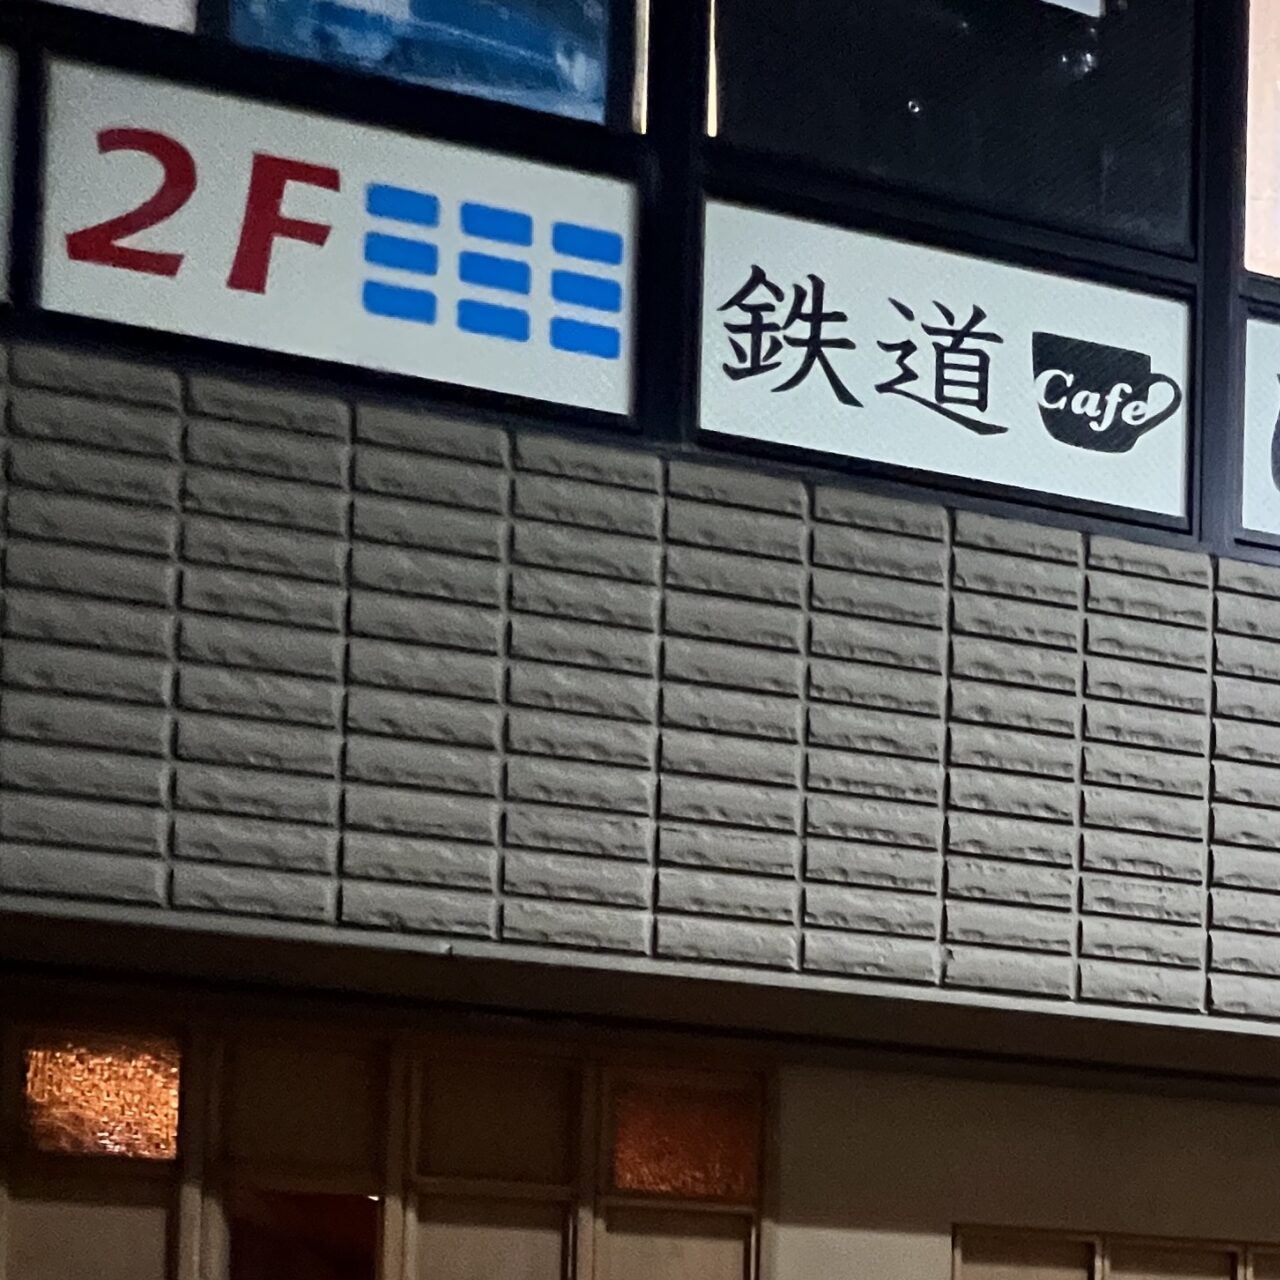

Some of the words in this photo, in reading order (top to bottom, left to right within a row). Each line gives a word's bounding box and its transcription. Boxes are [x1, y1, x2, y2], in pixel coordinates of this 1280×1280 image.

[65, 127, 342, 295] 2F
[716, 264, 1010, 435] 鉄道
[1034, 368, 1149, 432] Cafe
